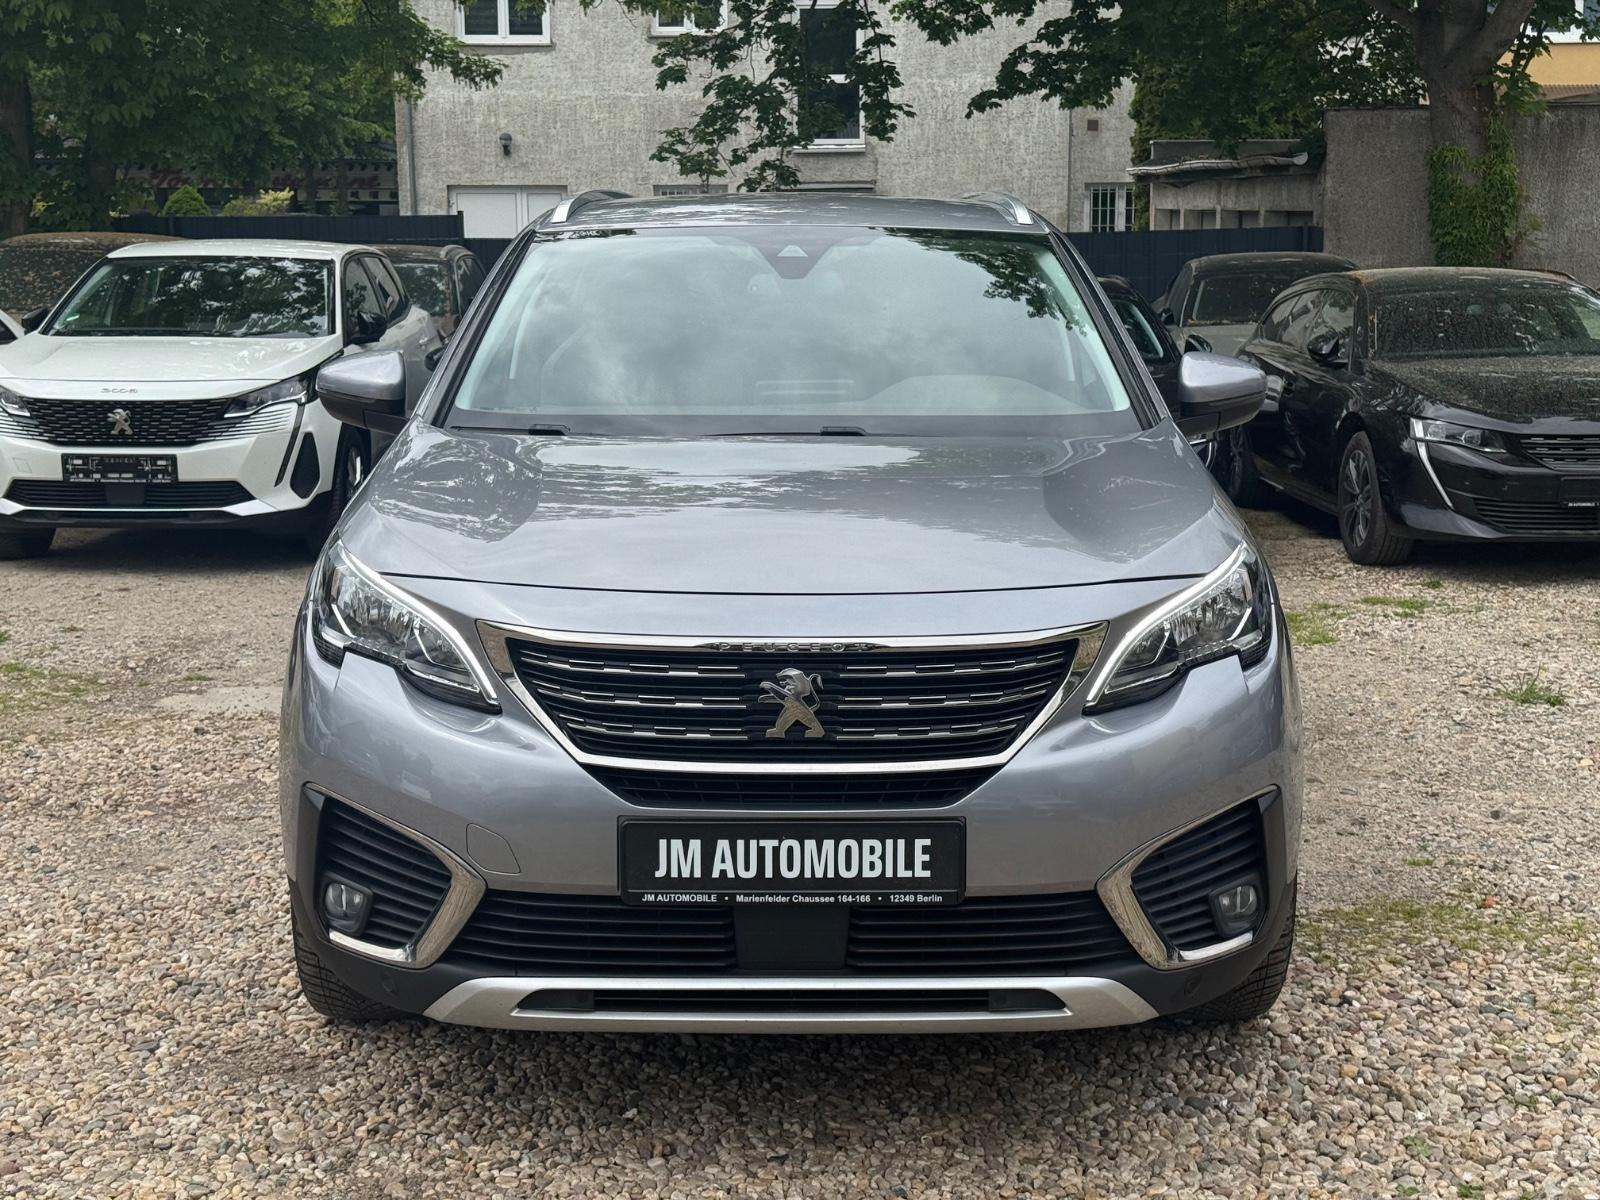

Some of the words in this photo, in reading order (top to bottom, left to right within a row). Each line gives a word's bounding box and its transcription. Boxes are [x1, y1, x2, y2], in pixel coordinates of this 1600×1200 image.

[654, 838, 702, 879] JM
[711, 838, 932, 879] AUTOMOBILE
[641, 893, 655, 902] JM
[656, 893, 718, 903] AUTOMOBILE
[736, 894, 790, 904] Marienfelder
[792, 894, 835, 904] Chaussee
[837, 894, 871, 903] 164-166
[889, 894, 915, 903] 12349
[916, 894, 943, 903] Berlin
